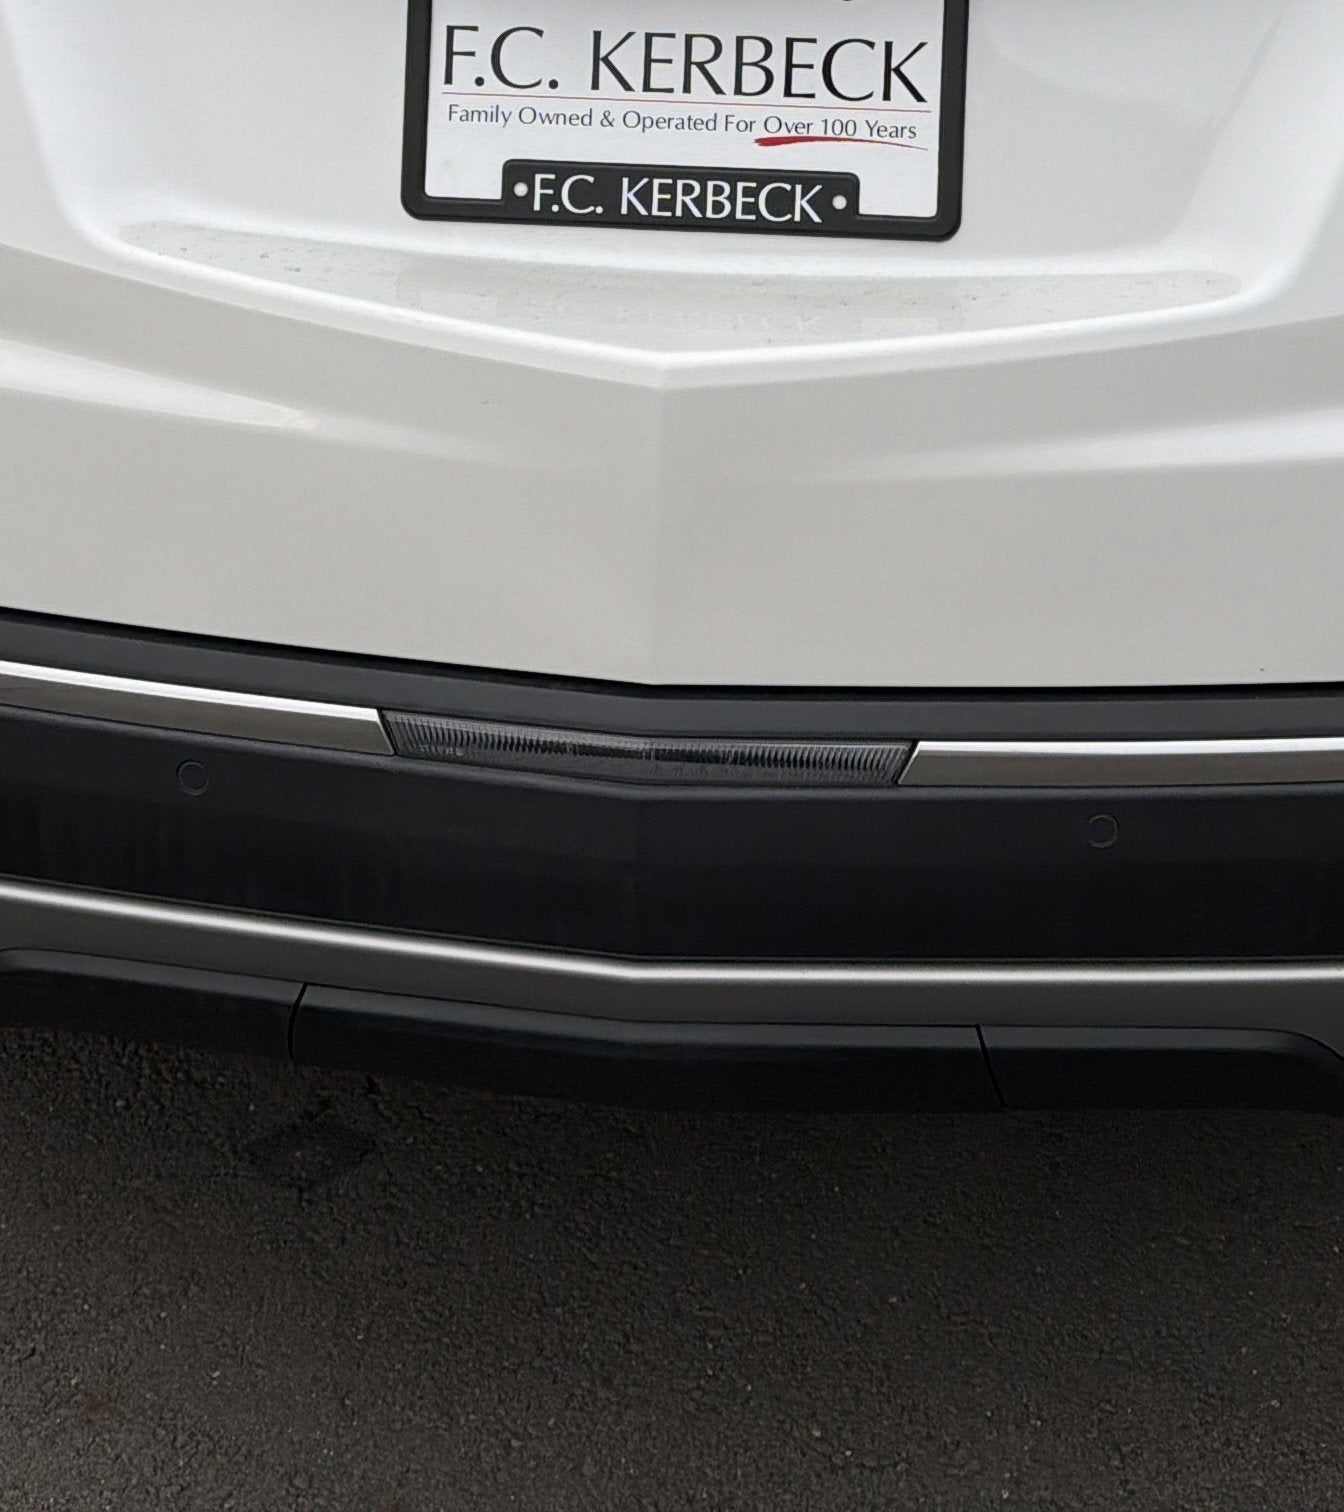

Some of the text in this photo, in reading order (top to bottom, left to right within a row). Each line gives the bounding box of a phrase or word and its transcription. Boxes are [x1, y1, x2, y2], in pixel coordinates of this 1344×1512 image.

[443, 24, 929, 103] F.C. KERBECK
[448, 104, 918, 140] Family Owned & Operated For Over 100 Years
[532, 173, 823, 223] F.C. KERBECK
